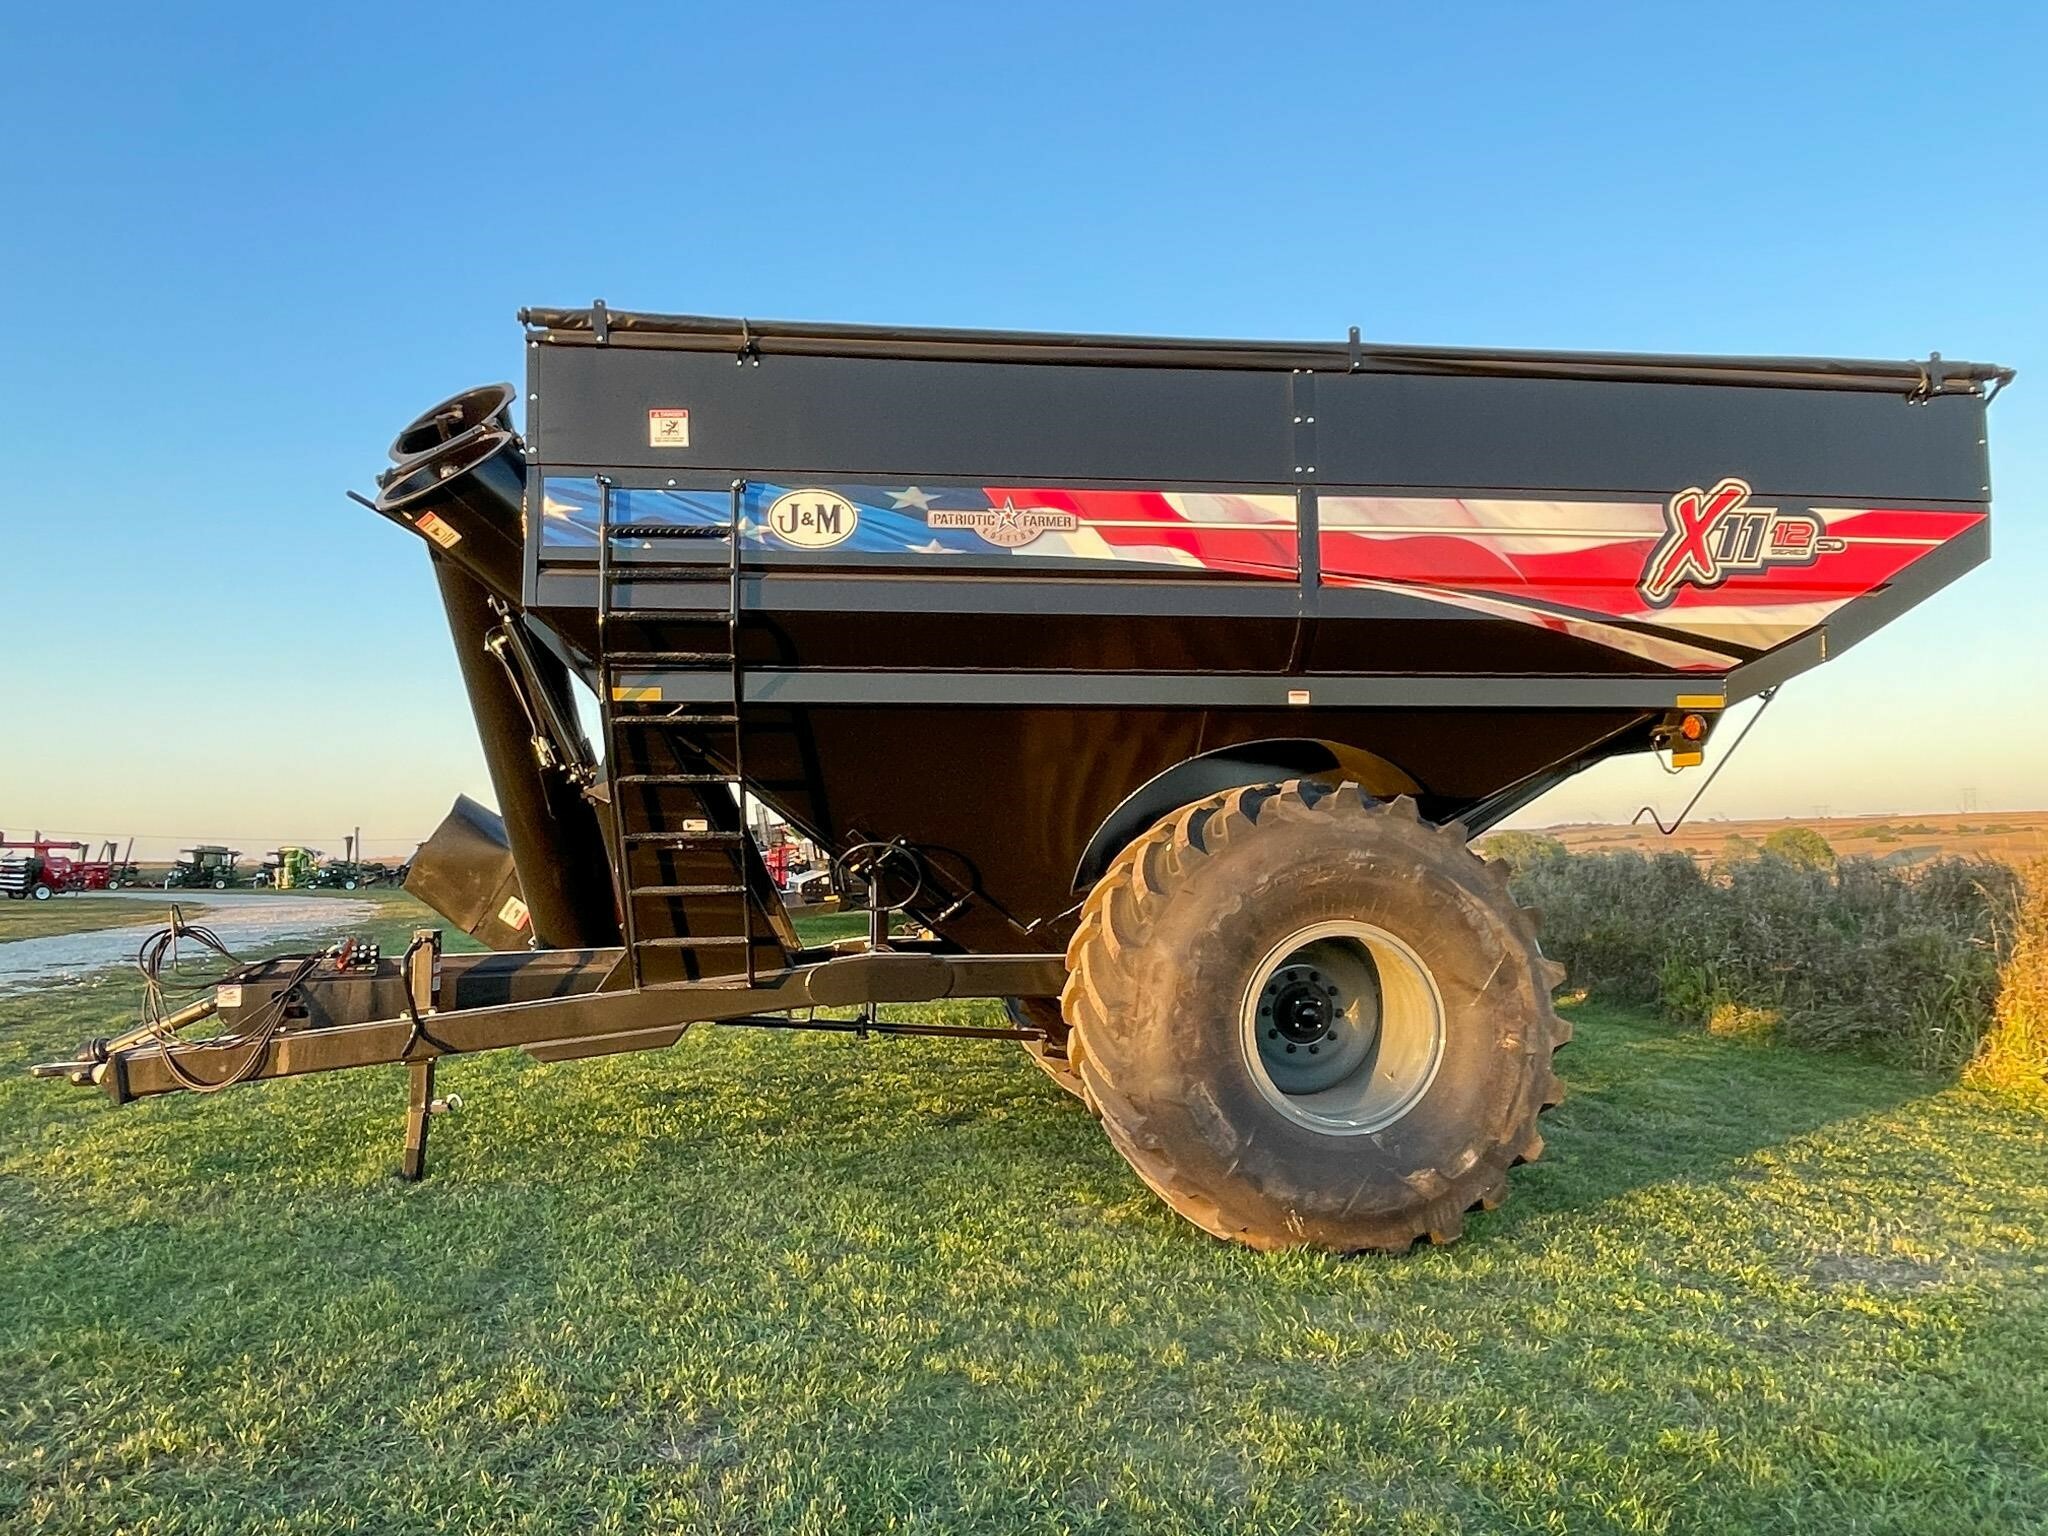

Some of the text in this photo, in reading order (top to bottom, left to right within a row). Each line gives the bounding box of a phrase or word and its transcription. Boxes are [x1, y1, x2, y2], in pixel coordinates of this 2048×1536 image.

[779, 502, 843, 534] J&M
[933, 514, 1073, 528] PATRIOTIC FARMER
[983, 526, 1036, 542] EDITION
[1771, 522, 1814, 546] 12
